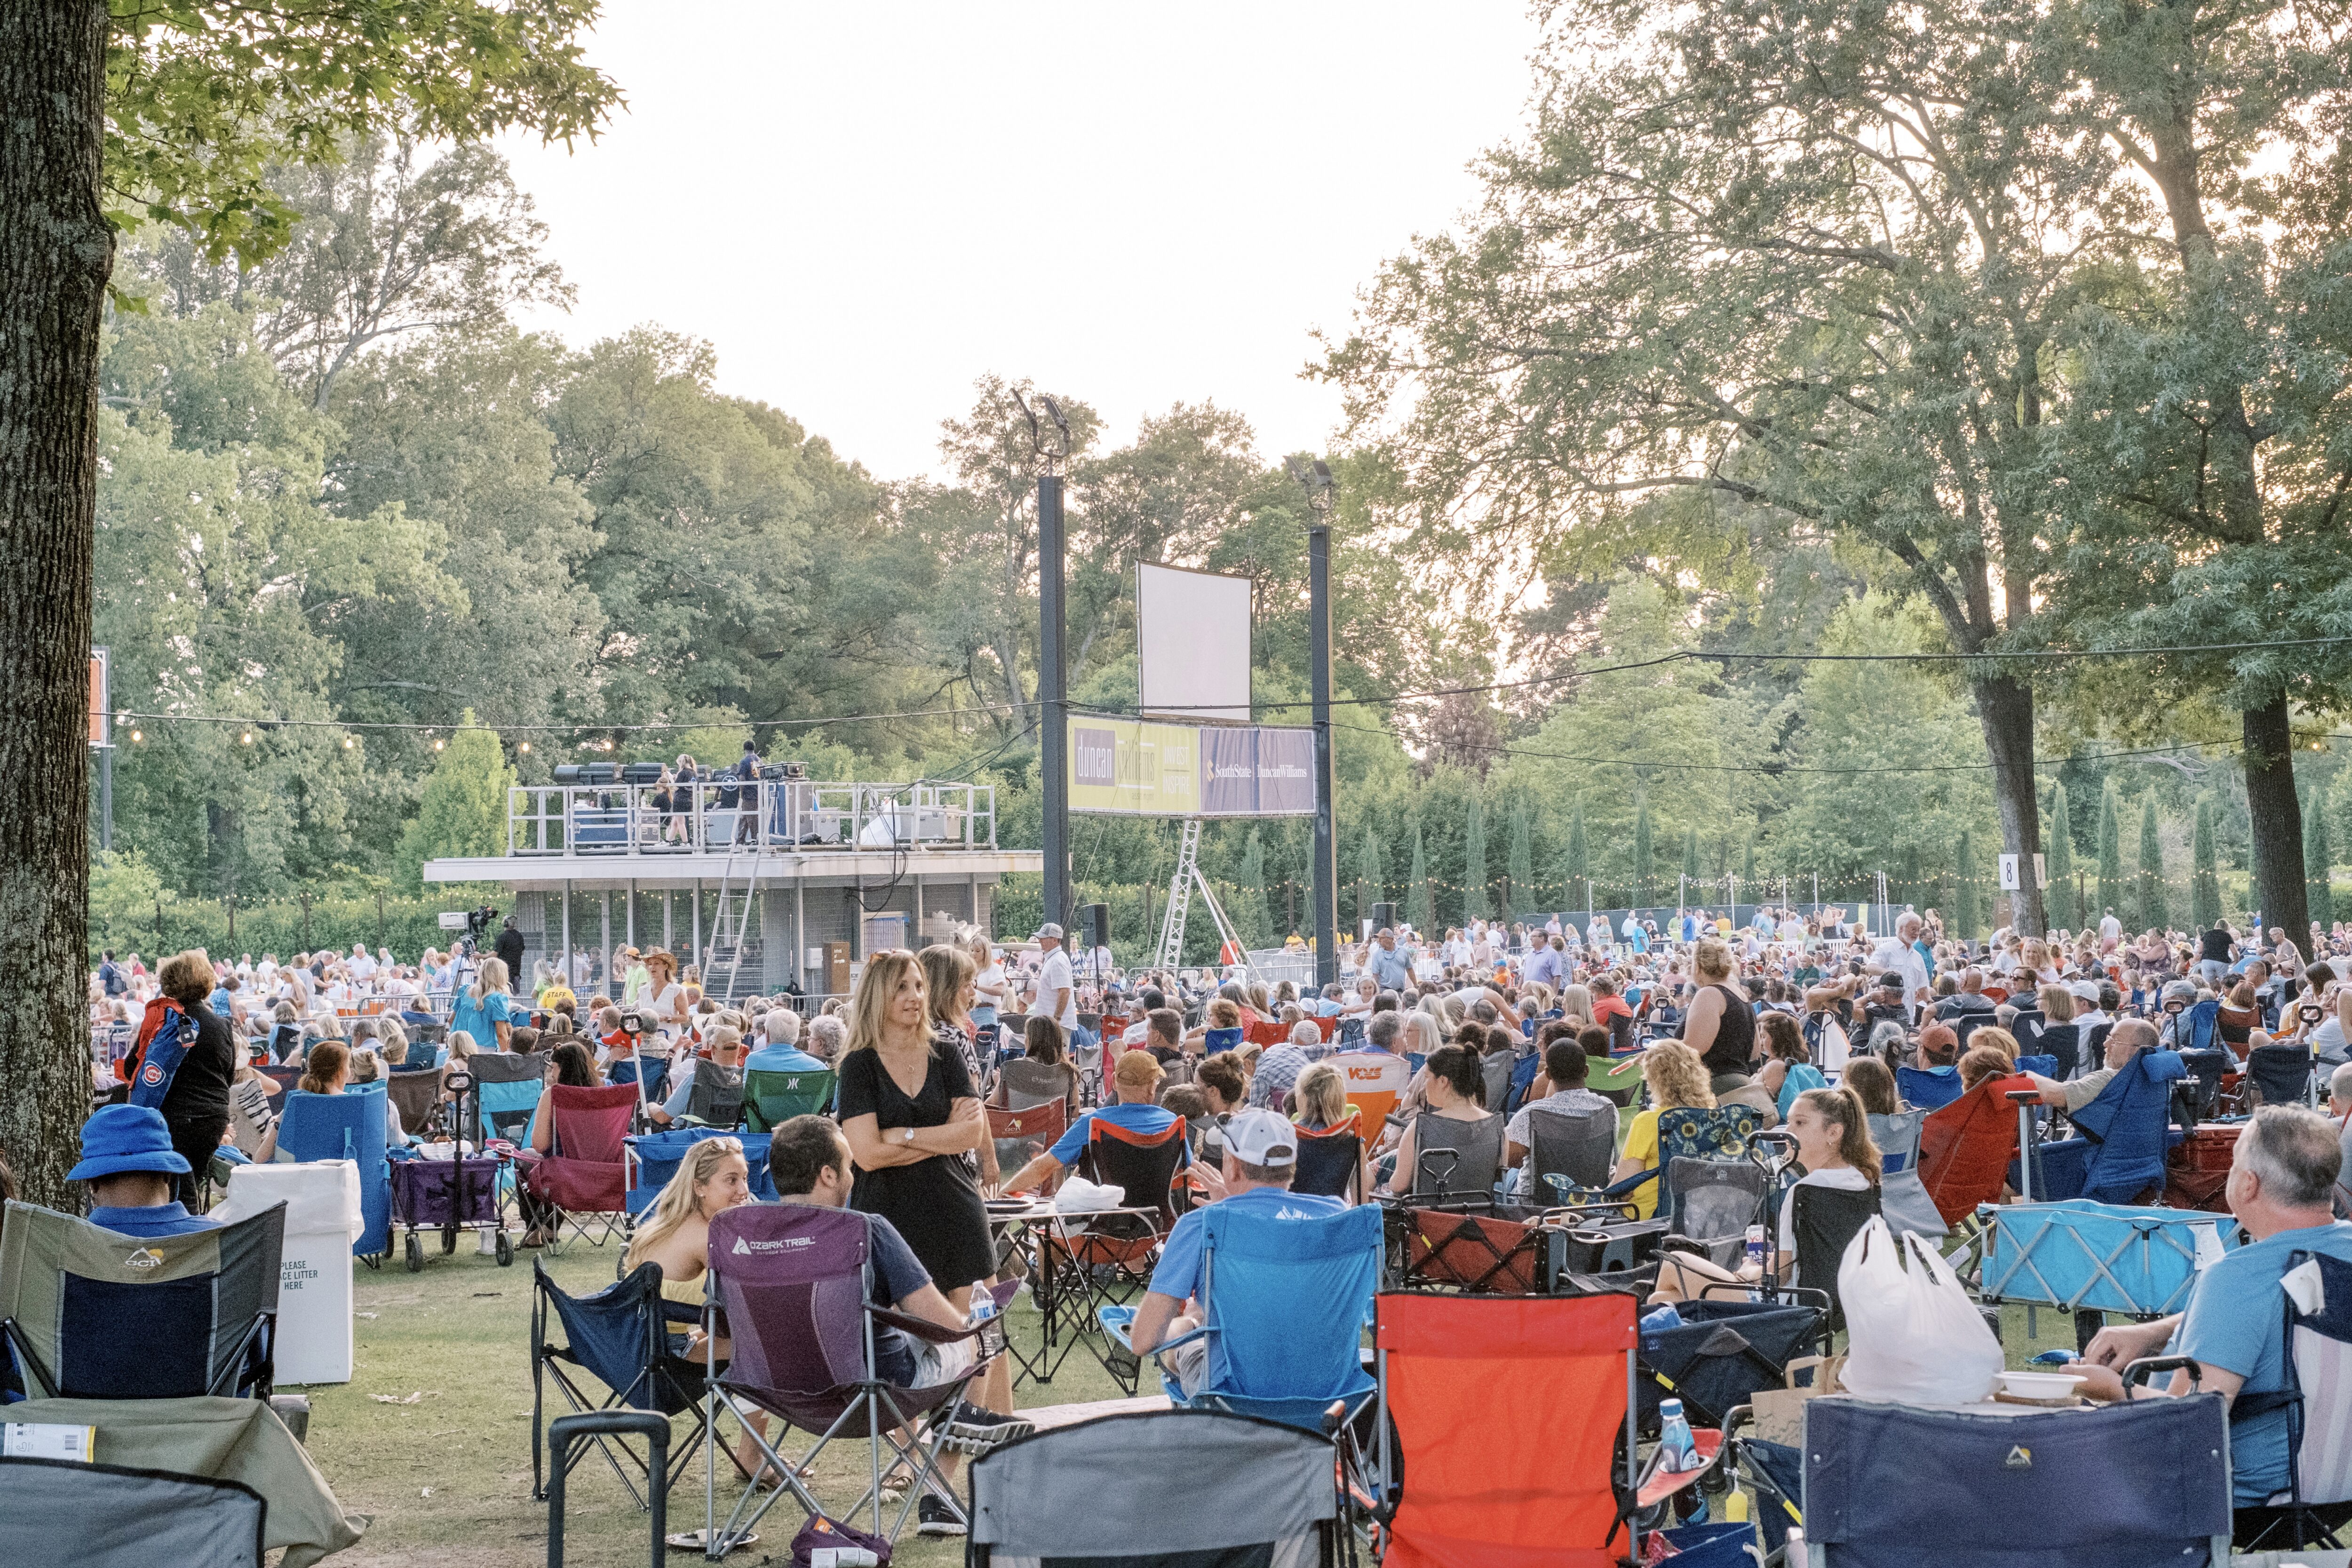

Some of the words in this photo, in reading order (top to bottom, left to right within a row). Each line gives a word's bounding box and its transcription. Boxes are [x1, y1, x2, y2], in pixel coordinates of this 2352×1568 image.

[1078, 734, 1112, 779] duncan
[1117, 739, 1154, 781] williams
[1164, 745, 1189, 765] INVEST
[1216, 764, 1252, 778] SouthState
[1256, 764, 1307, 778] DuncanWilliams
[1163, 775, 1190, 794] INSPIRE
[2006, 861, 2012, 883] 8
[2038, 861, 2042, 882] 8
[285, 1281, 303, 1289] HERE
[294, 1270, 318, 1280] LITTER
